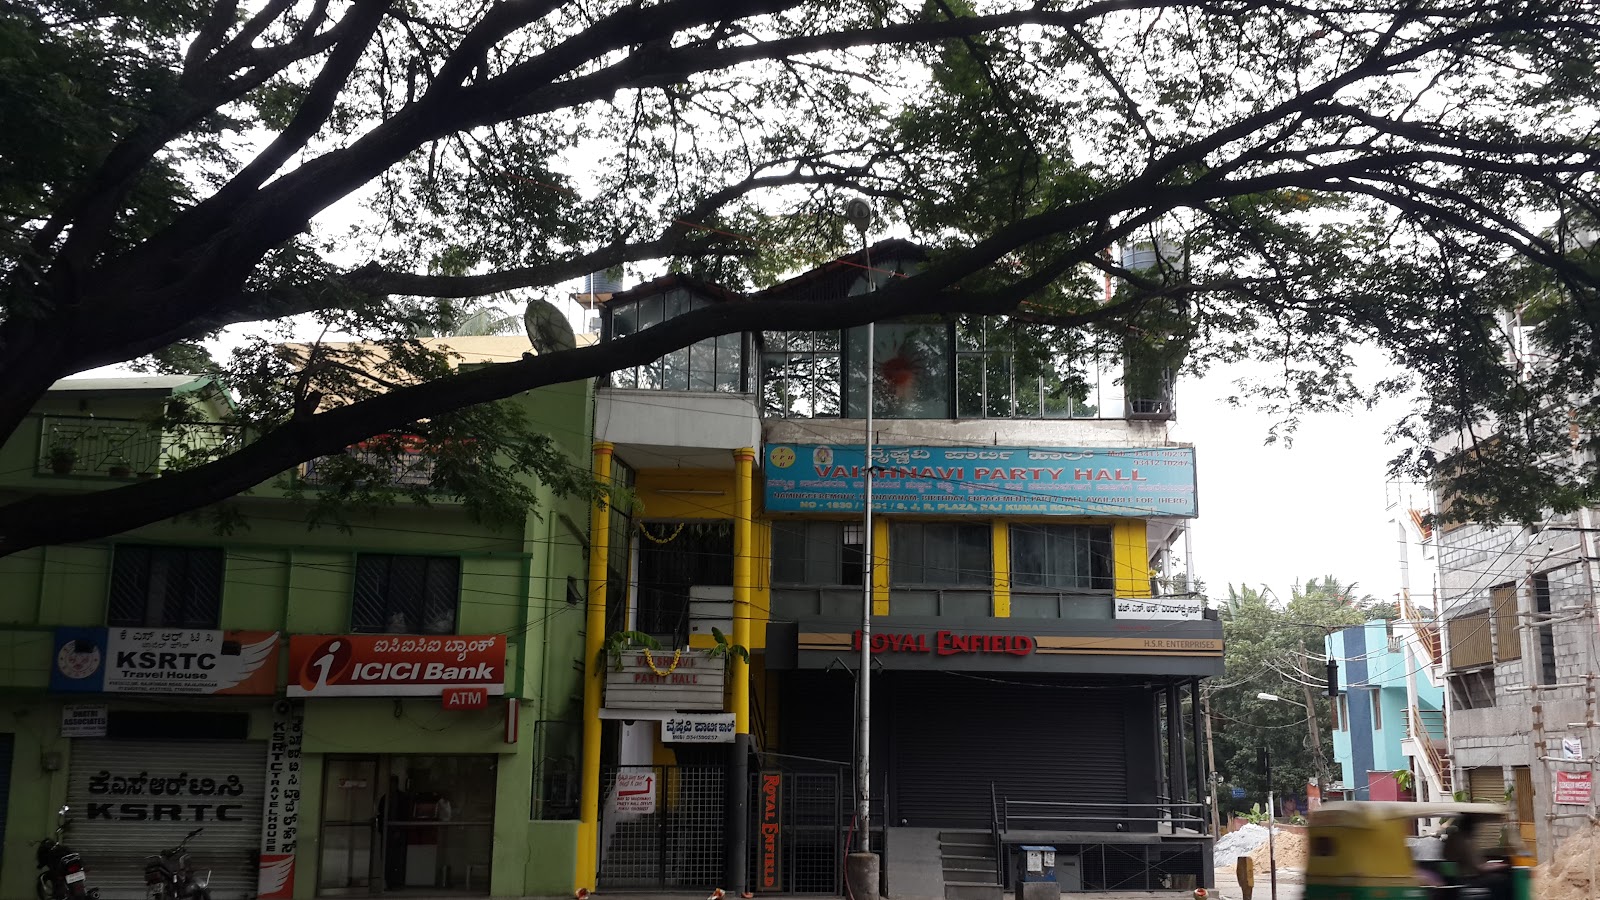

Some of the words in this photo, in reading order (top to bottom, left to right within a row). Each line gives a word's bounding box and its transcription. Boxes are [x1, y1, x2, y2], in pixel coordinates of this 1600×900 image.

[974, 466, 1065, 481] PARTY
[1074, 468, 1147, 482] HALL
[373, 638, 442, 652] ಐಸಿಐಸಿಐ
[444, 637, 496, 662] ಬ್ಯಾಂಕ್
[937, 630, 1033, 655] ENFIELD
[1144, 640, 1165, 648] H.S.R.
[1167, 640, 1215, 649] ENTERPRISES
[116, 651, 216, 670] KSRTC
[122, 670, 163, 679] Travel
[167, 671, 208, 680] House
[351, 662, 421, 680] ICICI
[423, 662, 495, 680] Bank
[635, 673, 667, 683] PARTY
[672, 674, 698, 684] HALL
[450, 692, 481, 704] ATM
[763, 774, 780, 821] ROYAL
[87, 803, 243, 821] K.S.R.T.C
[762, 823, 779, 888] ENFIELD
